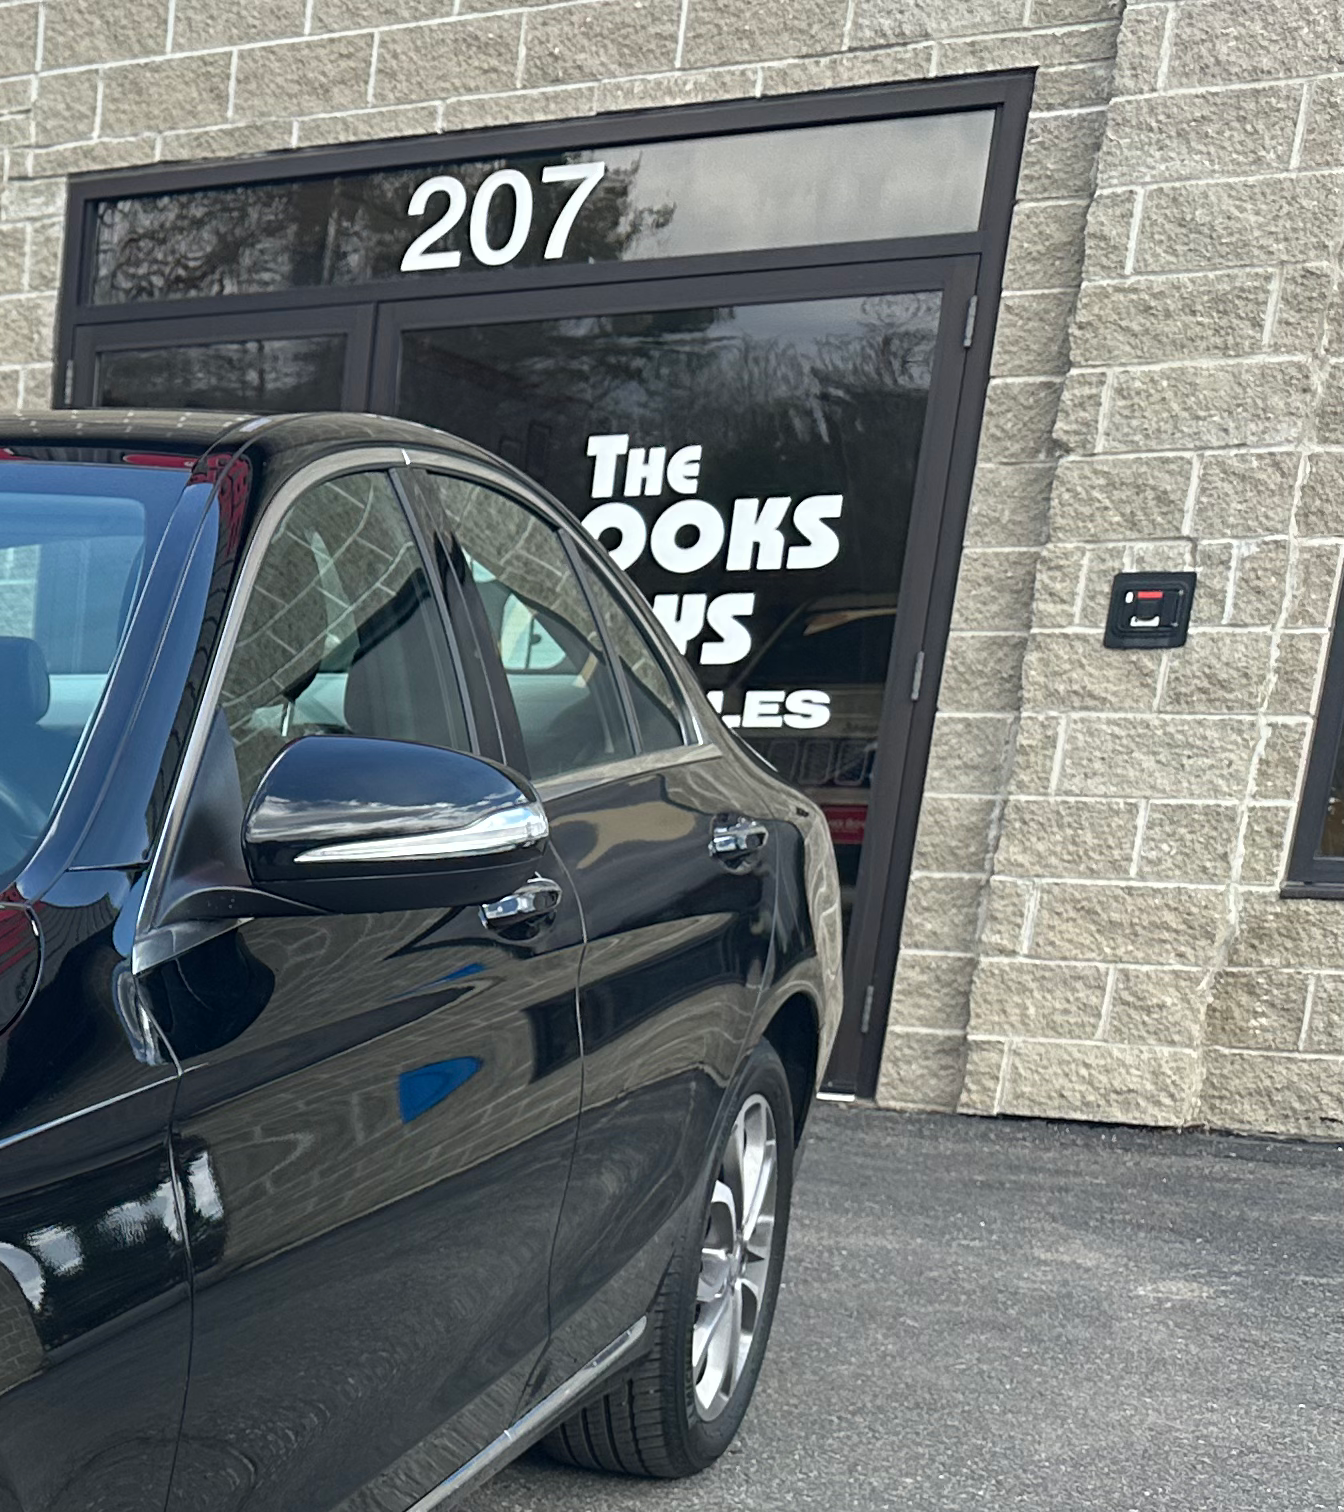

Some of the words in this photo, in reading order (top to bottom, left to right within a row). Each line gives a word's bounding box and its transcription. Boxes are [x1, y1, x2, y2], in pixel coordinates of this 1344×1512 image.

[401, 160, 607, 272] 207
[585, 434, 703, 499] THE
[581, 493, 845, 574] OOKS
